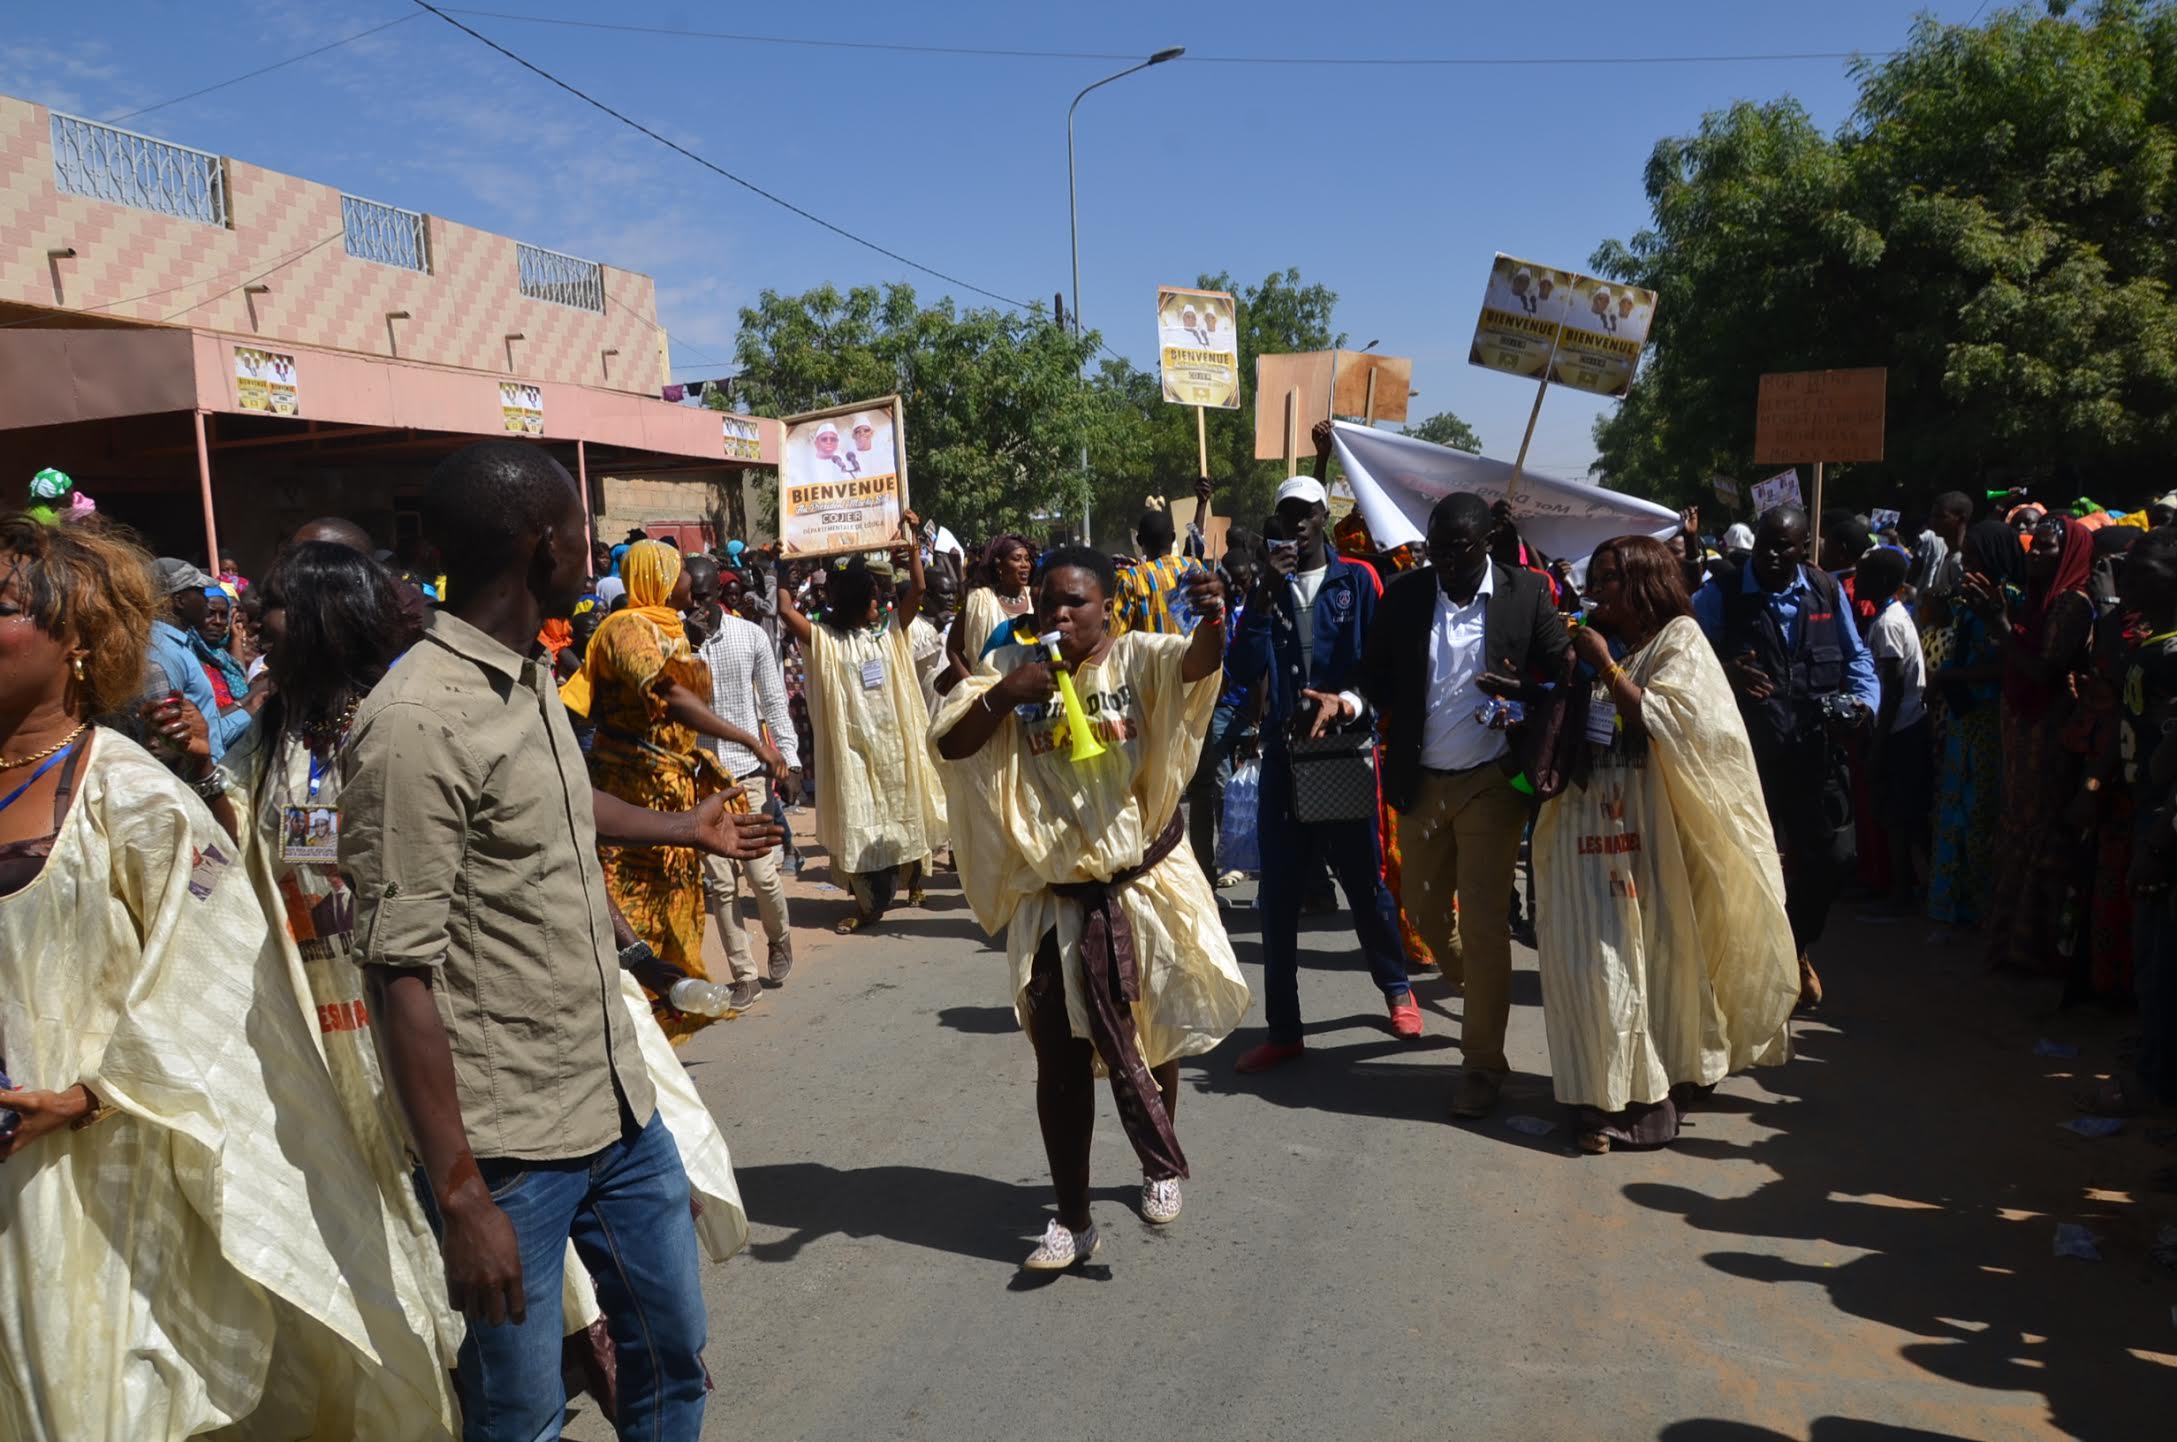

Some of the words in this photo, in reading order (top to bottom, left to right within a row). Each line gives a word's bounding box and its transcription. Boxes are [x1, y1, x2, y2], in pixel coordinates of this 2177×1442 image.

[1487, 311, 1554, 335] BIENVENUE
[1566, 329, 1634, 354] BIENVENUE
[1170, 349, 1229, 364] BIENVENUE
[792, 476, 895, 504] BIENVENUE
[822, 511, 862, 524] COJER
